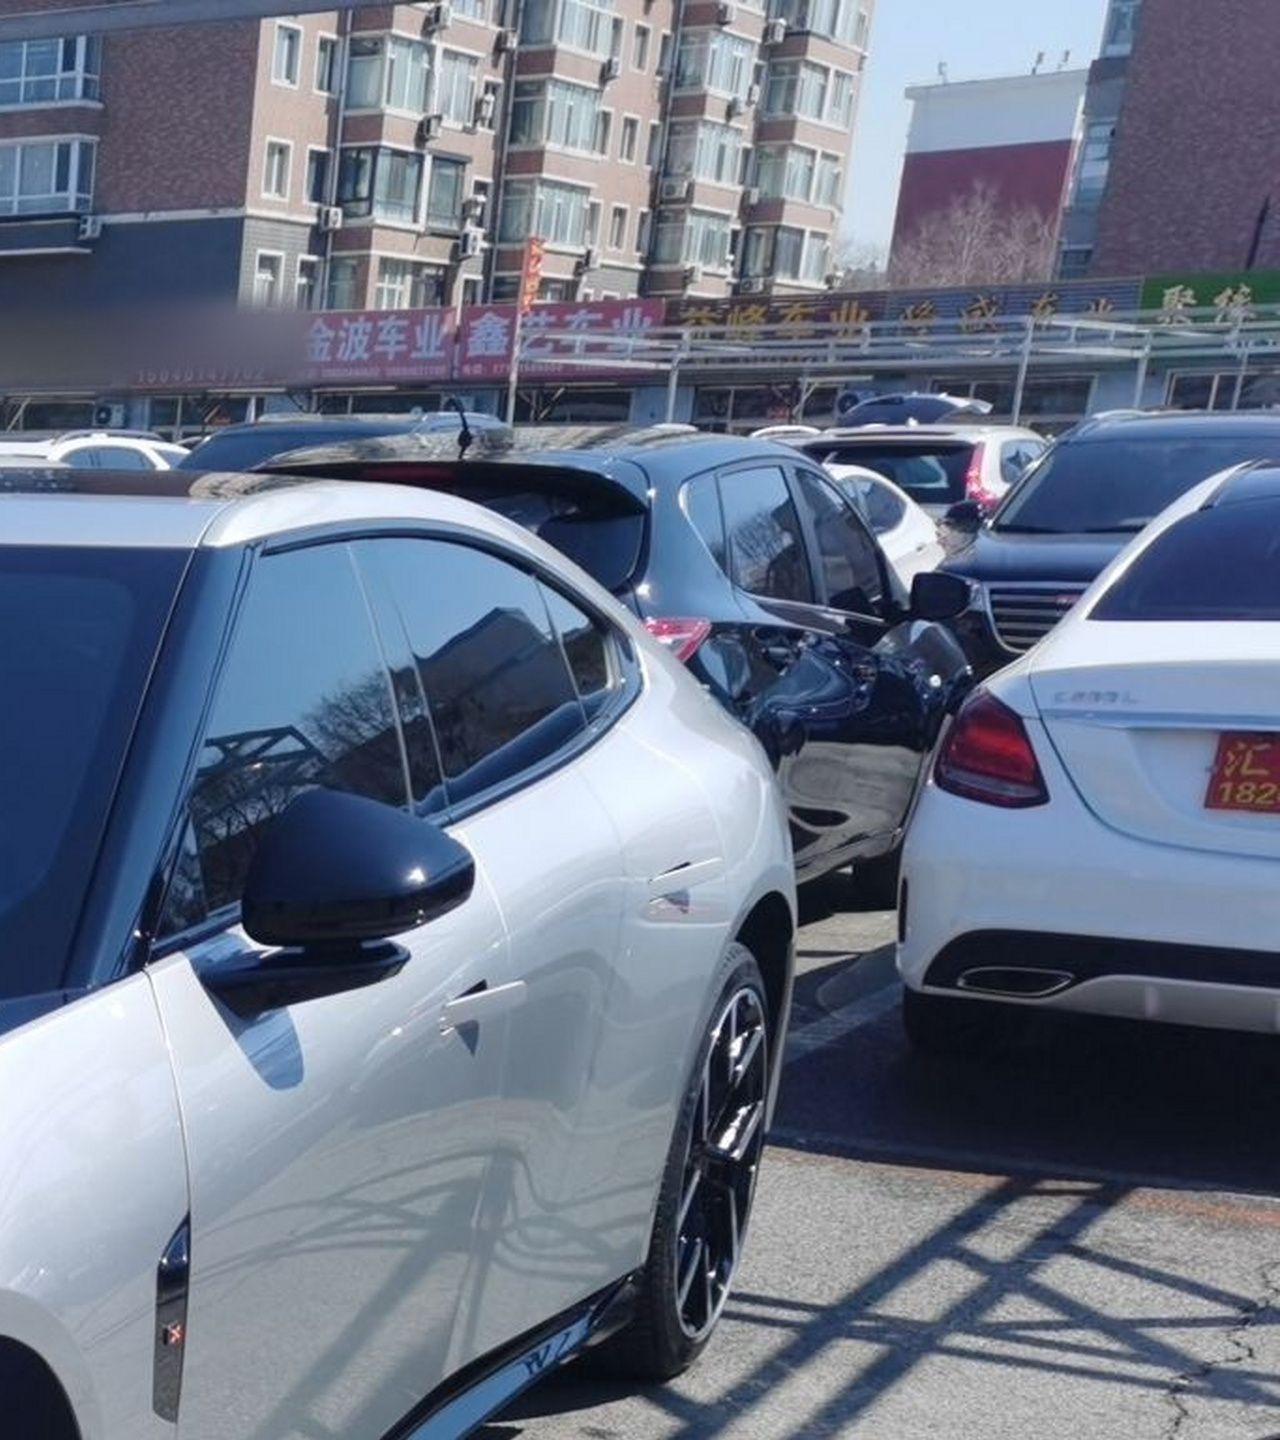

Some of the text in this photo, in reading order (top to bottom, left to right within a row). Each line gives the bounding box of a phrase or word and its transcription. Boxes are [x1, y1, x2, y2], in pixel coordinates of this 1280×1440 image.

[306, 313, 446, 362] 金波车业
[1219, 781, 1280, 805] 182
